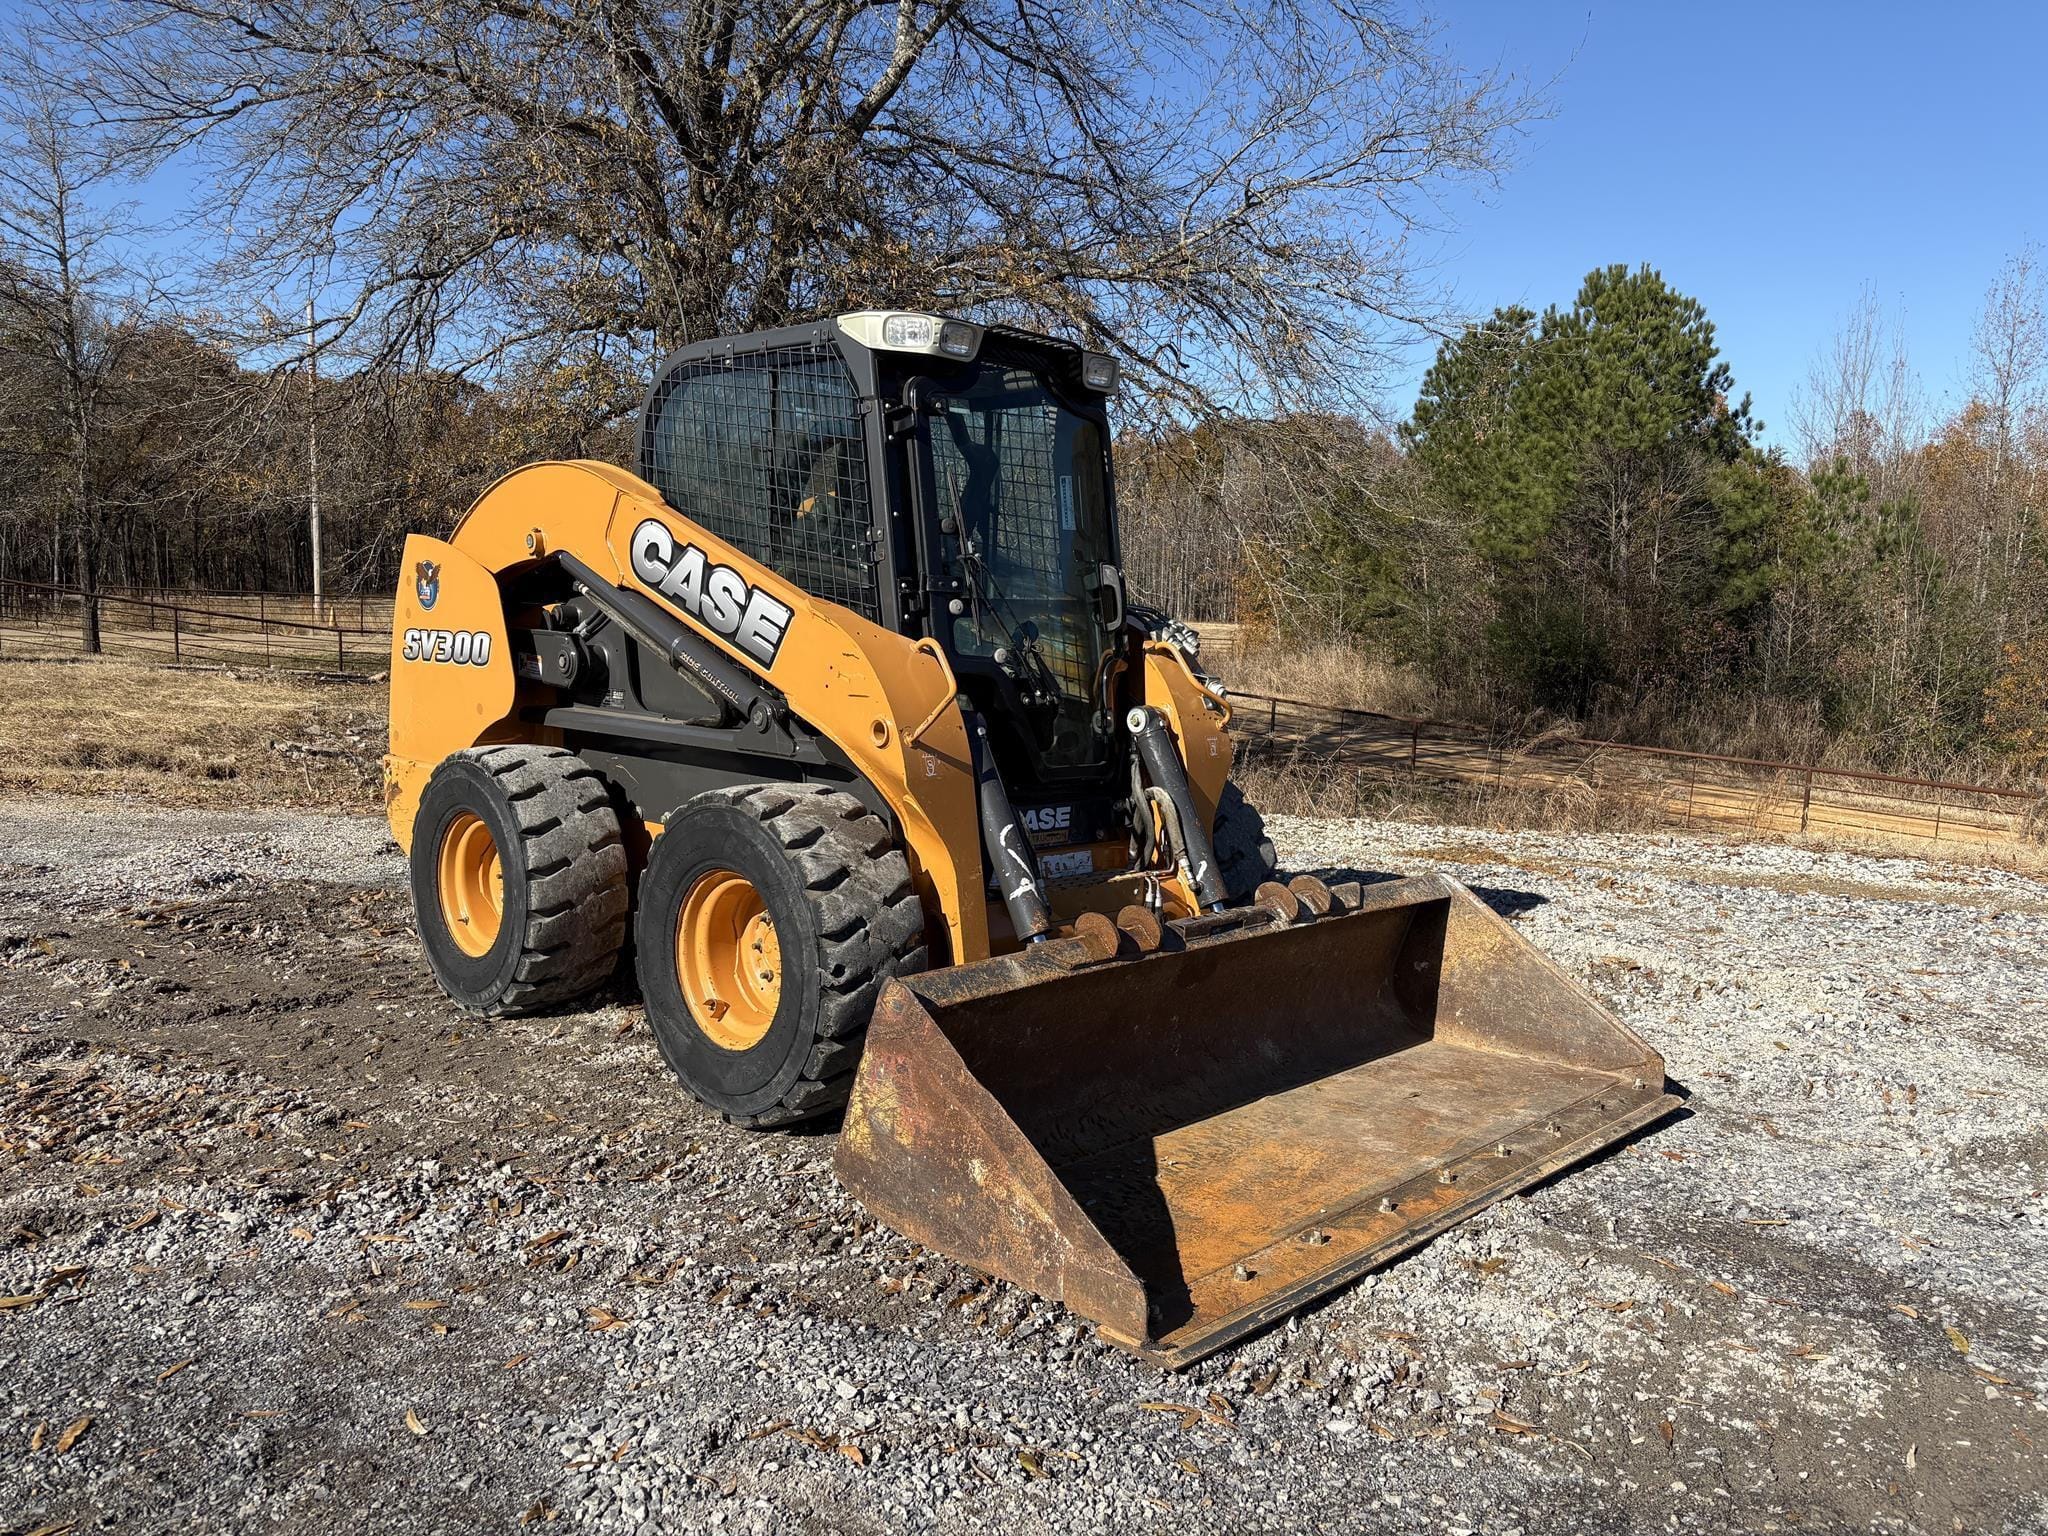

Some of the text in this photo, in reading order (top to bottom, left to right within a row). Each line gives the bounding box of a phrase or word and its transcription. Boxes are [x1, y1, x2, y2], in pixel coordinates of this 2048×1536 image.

[631, 519, 793, 667] CASE
[403, 628, 492, 666] SV300
[700, 668, 739, 704] CONTROL
[1024, 806, 1071, 831] ASE
